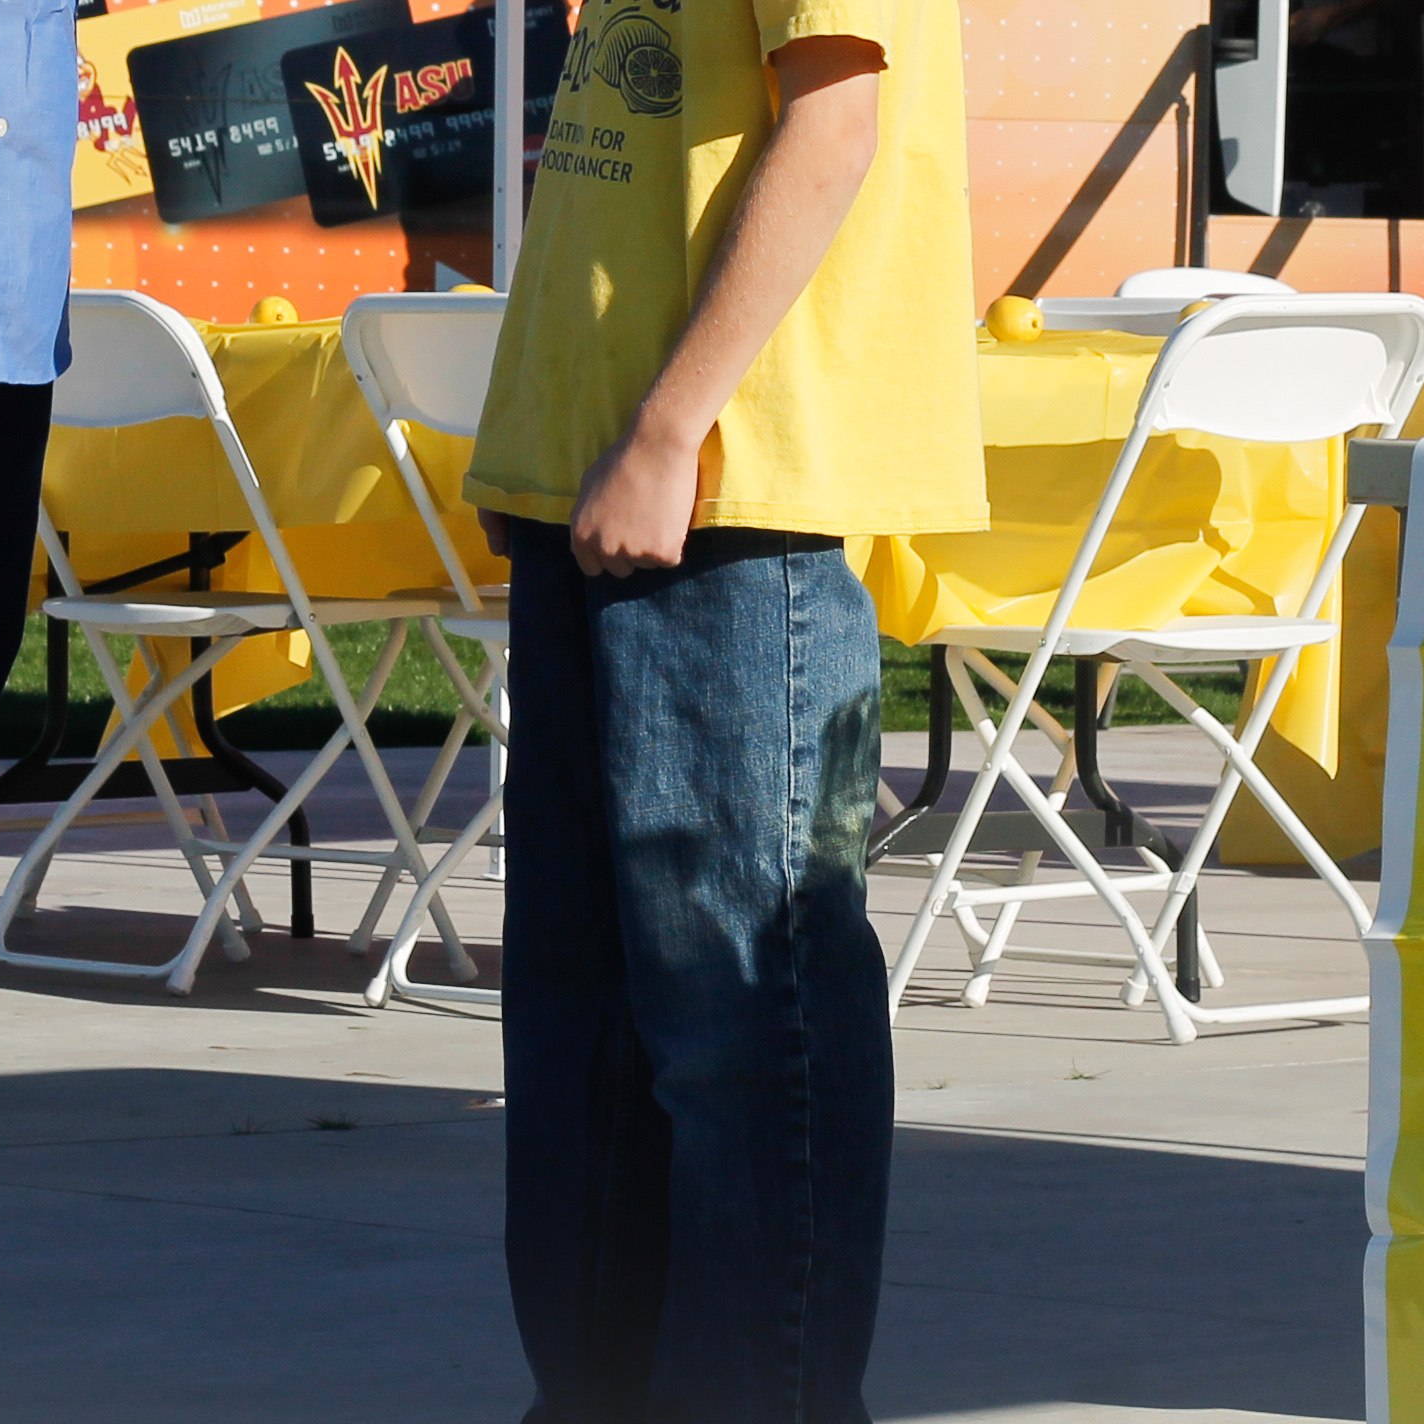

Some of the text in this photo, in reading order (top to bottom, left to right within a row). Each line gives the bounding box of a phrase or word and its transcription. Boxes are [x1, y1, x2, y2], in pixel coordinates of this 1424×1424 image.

[393, 57, 473, 114] ASU
[168, 116, 280, 158] 5419 8499
[590, 127, 626, 152] FOR
